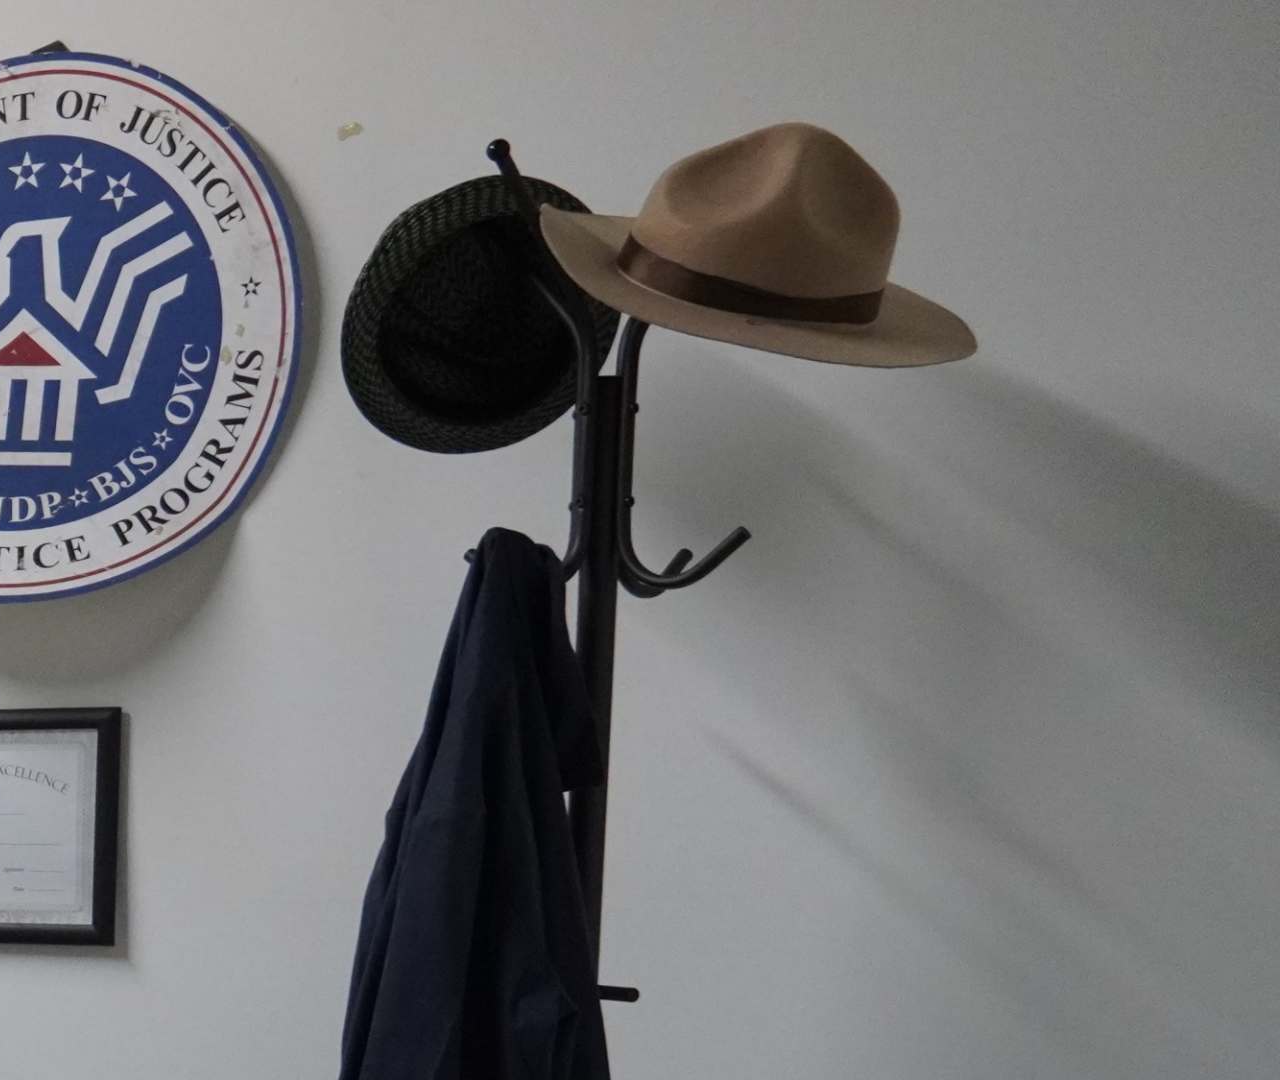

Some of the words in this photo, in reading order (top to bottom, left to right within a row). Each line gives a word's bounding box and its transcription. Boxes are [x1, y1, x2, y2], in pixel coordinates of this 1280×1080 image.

[55, 88, 108, 121] OF
[119, 106, 247, 234] JUSTICE
[86, 446, 158, 501] BJS
[164, 343, 212, 427] OVC
[111, 349, 266, 546] PROGRAMS
